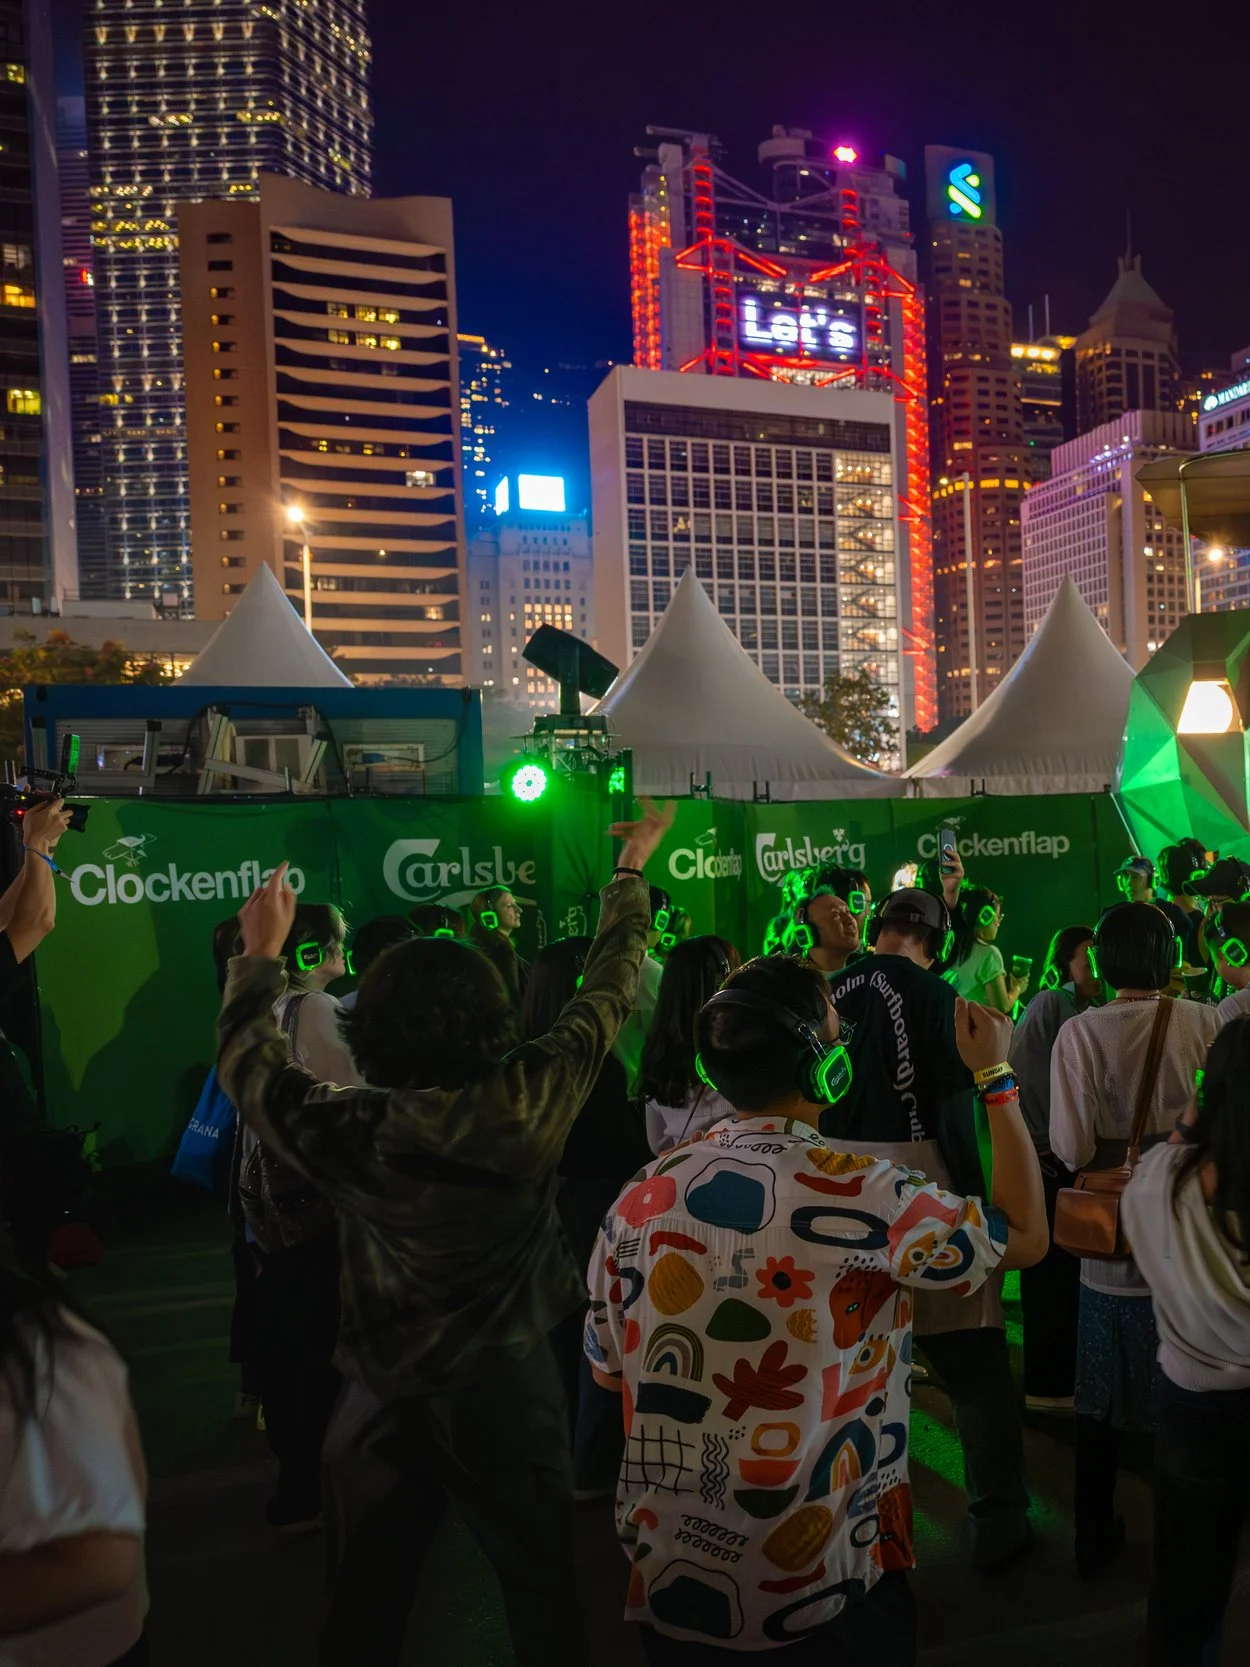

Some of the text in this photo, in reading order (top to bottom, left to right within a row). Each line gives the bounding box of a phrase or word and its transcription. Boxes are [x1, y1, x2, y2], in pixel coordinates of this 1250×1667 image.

[744, 299, 857, 352] Let's
[756, 833, 866, 887] Carlsberg
[917, 831, 1070, 859] Cckenflap
[870, 970, 915, 1090] (Surfboard)
